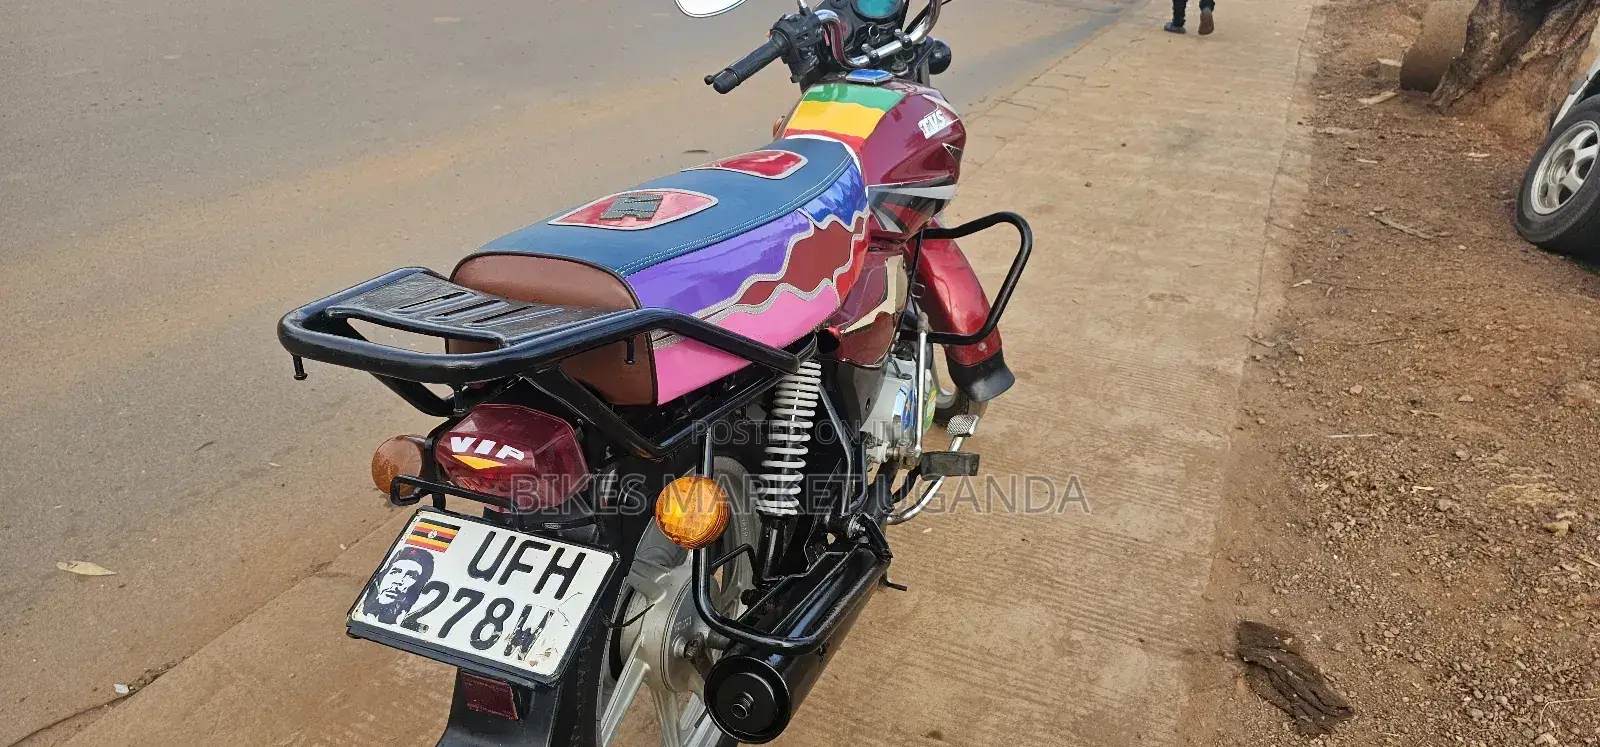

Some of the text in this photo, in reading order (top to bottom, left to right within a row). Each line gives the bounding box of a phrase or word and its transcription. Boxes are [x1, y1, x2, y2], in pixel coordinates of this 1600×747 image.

[917, 109, 947, 139] TVS
[450, 436, 525, 461] VIP
[467, 531, 586, 601] UFH
[400, 580, 555, 661] 278W
